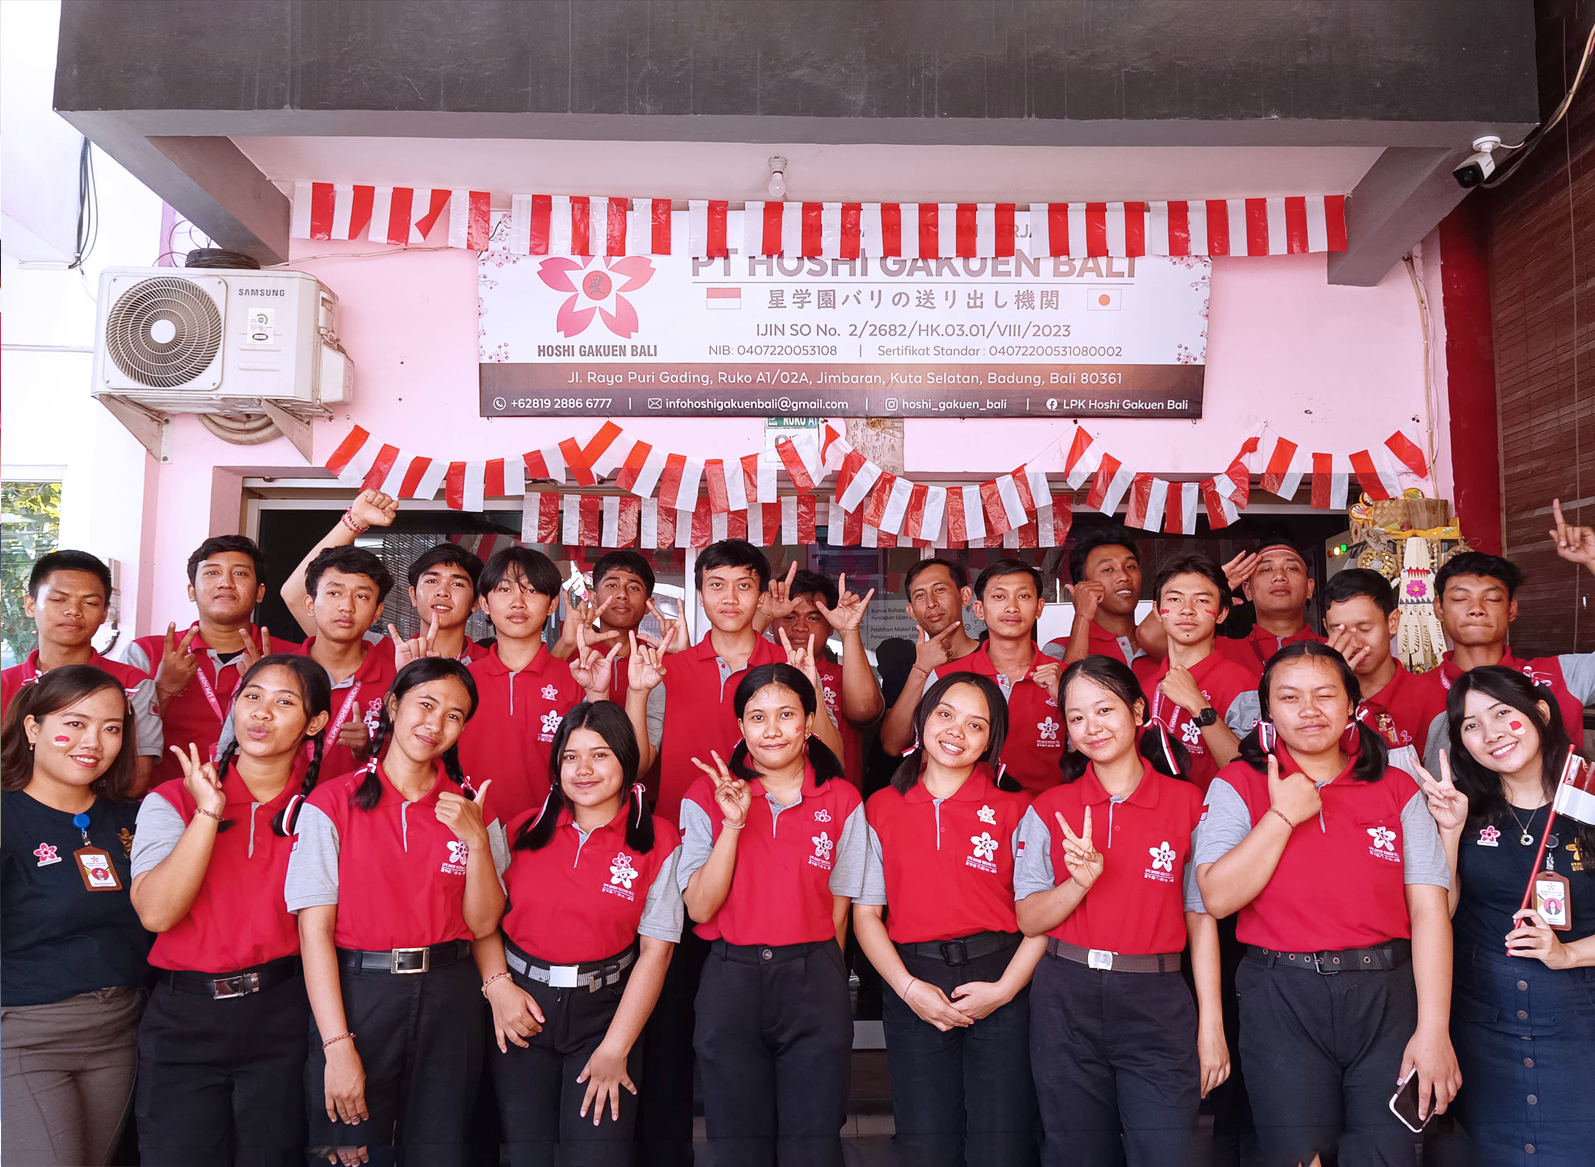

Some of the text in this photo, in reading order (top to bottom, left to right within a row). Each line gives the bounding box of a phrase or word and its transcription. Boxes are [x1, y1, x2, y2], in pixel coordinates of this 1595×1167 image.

[692, 248, 1135, 278] PT HOSHI GAKUEN BALI
[238, 288, 286, 297] SAMSUNG
[767, 288, 1060, 311] 星学園バリの送り出し機関
[756, 320, 1072, 339] IJIN SO No. 2/2682/HK.03.01/VIII/2023
[537, 344, 658, 358] HOSHI GAKUEN BALI
[709, 344, 838, 357] NIB: 0407220053108
[877, 345, 930, 357] Sertifikat
[933, 345, 981, 357] Standar
[988, 345, 1123, 358] 04072200531080002
[587, 371, 623, 387] Raya
[628, 371, 656, 385] Puri
[659, 371, 714, 387] Gading,
[718, 371, 752, 385] Ruko
[755, 369, 813, 387] A1/02A,
[816, 371, 886, 387] Jimbaran,
[890, 372, 924, 385] Kuta
[927, 372, 985, 387] Selatan,
[987, 372, 1045, 388] Badung,
[1050, 372, 1077, 385] Bali
[1080, 372, 1123, 385] 80361
[510, 397, 613, 410] +62819 2886 6777
[665, 396, 849, 412] infohoshigakuenbali@gmail.com
[902, 398, 1008, 412] hoshi_gakuen_bali
[1063, 399, 1189, 411] LPK Hoshi Gakuen Bali
